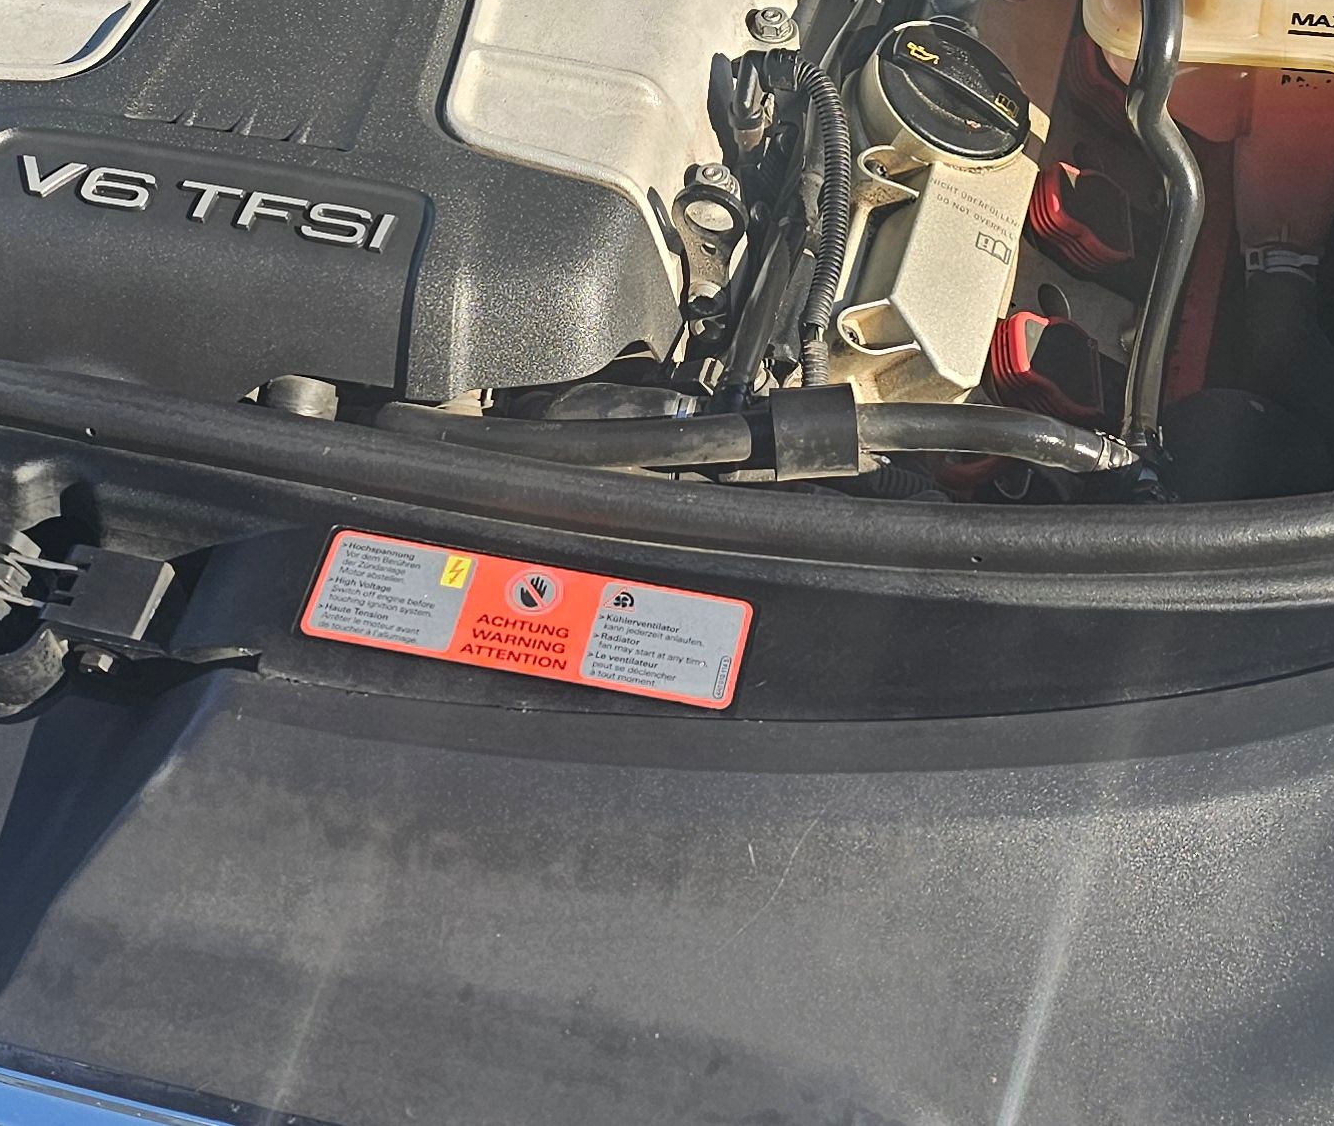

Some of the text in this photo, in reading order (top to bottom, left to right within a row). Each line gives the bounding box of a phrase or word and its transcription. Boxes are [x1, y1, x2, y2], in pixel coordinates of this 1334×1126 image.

[18, 154, 397, 254] V6 TFSI
[937, 194, 949, 204] DO
[953, 201, 970, 214] NOT
[348, 542, 415, 561] Hochspannung
[335, 576, 392, 592] High Voltage
[331, 585, 435, 609] Switch off engine before
[325, 603, 389, 621] Haute Tension
[477, 614, 569, 638] ACHTUNG
[606, 613, 680, 634] Kühlerventilator
[472, 628, 565, 653] WARNING
[601, 633, 640, 646] Radiator
[459, 643, 567, 670] ATTENTION
[599, 641, 612, 649] fan
[614, 644, 633, 655] may
[635, 649, 655, 659] start
[667, 654, 684, 664] any
[609, 655, 658, 669] ventilateur
